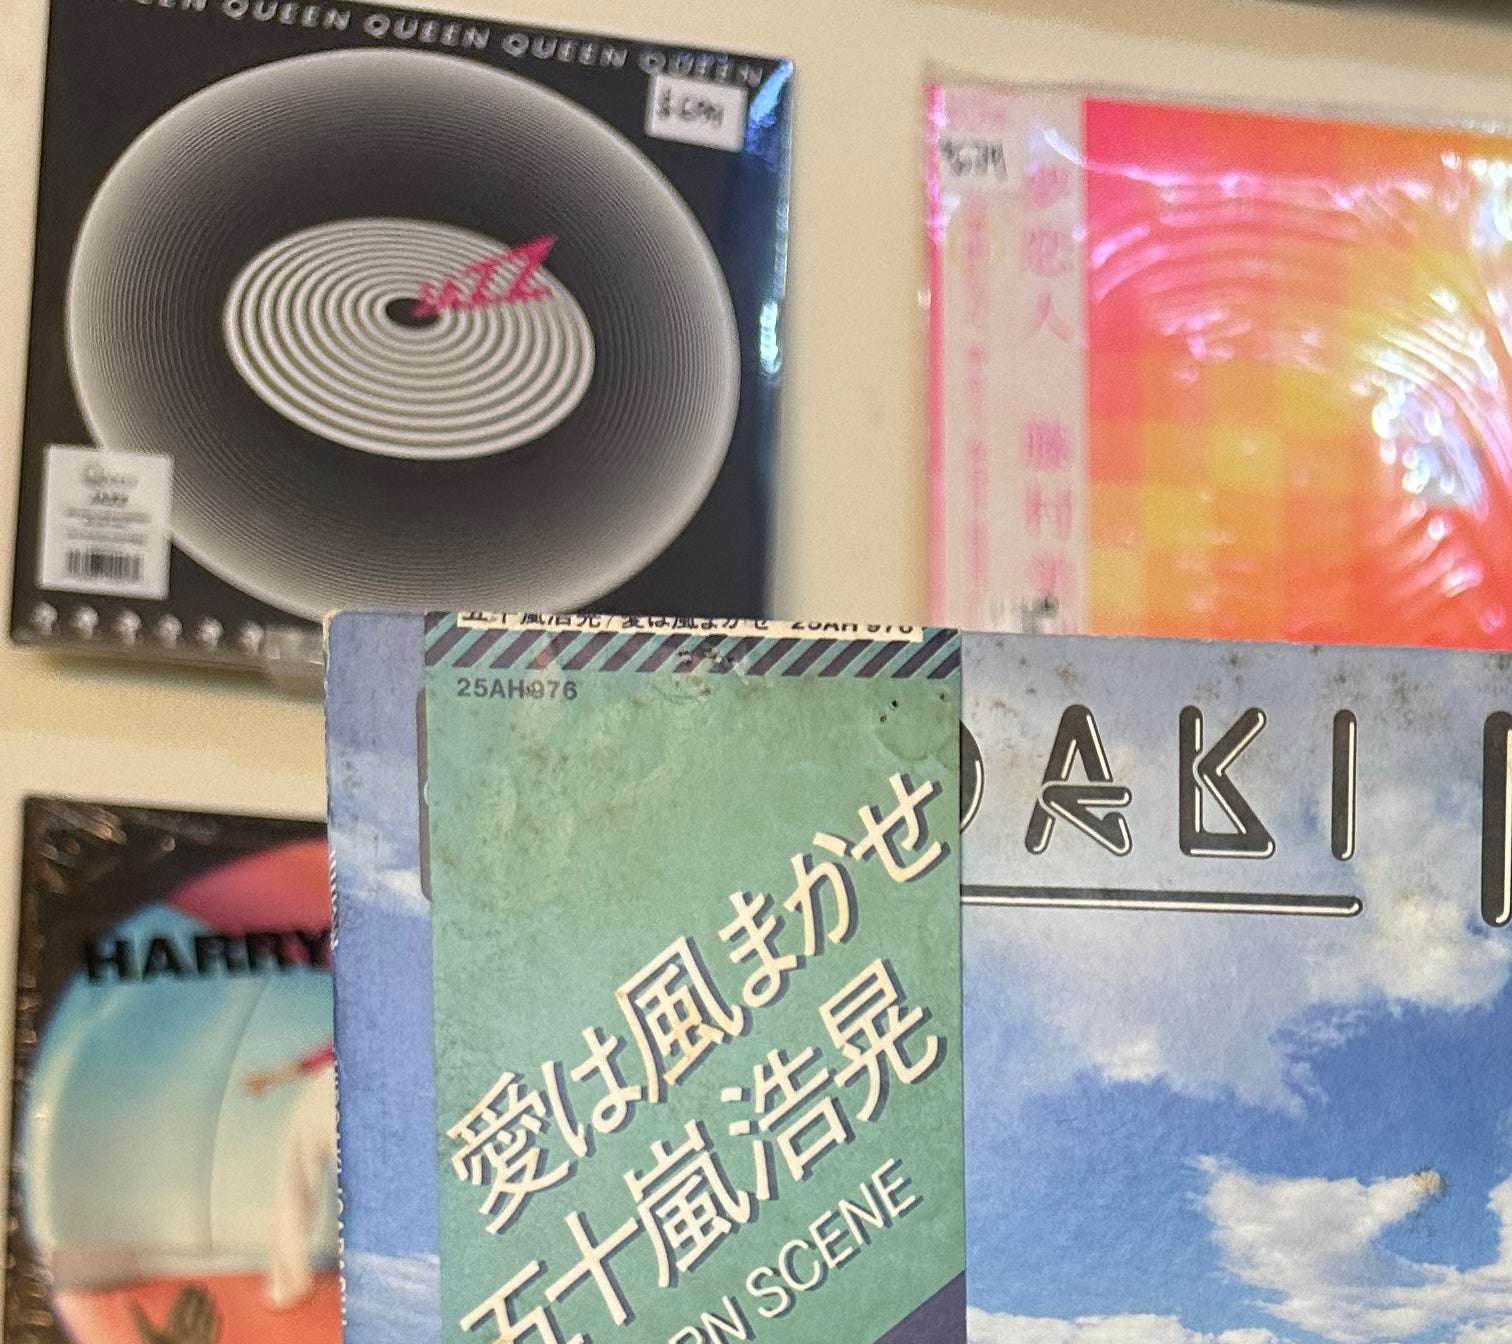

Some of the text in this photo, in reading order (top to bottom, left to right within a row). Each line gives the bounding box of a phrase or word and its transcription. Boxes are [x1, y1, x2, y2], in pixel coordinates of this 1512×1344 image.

[362, 13, 491, 50] QUEEN
[502, 32, 628, 68] QUEEN
[446, 772, 949, 1236] 愛は風まかせ
[744, 1158, 922, 1319] SCENE
